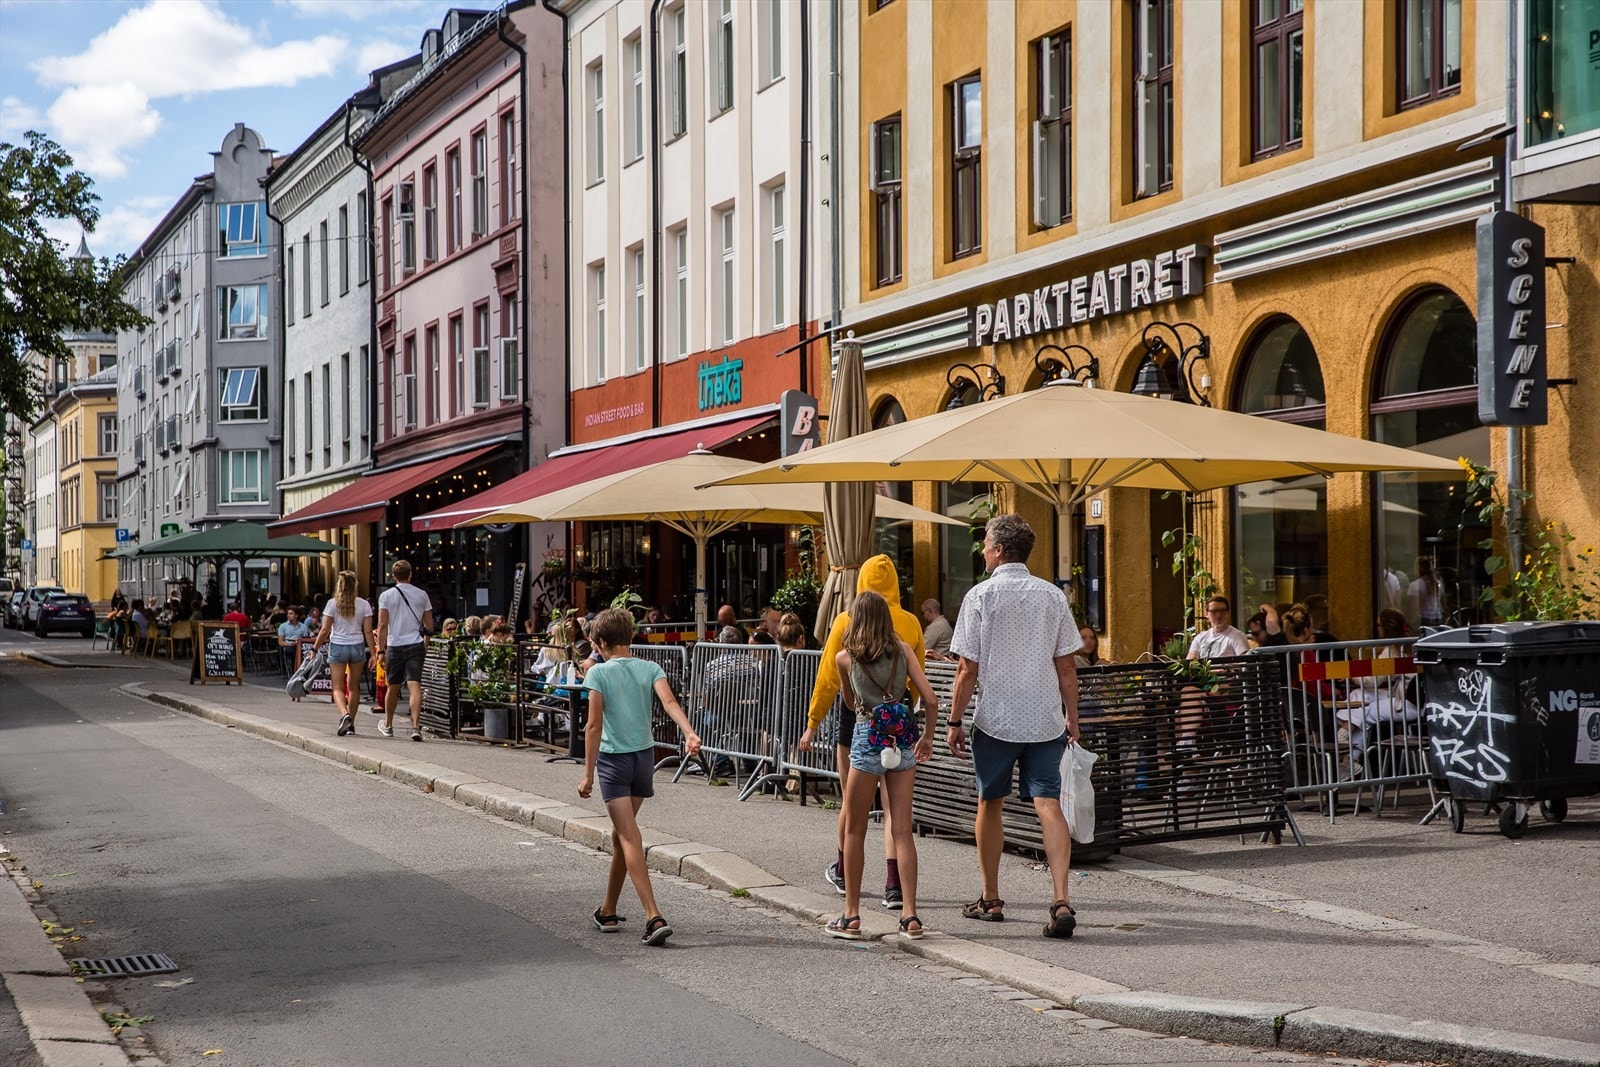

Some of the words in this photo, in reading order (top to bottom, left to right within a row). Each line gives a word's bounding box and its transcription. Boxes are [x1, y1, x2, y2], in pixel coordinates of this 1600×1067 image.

[975, 243, 1198, 347] PARKTEATRET
[1505, 237, 1538, 410] SCENE
[698, 354, 743, 412] theka
[585, 411, 600, 427] INDIAN
[600, 408, 616, 424] STREET
[616, 405, 631, 420] FOOD
[634, 402, 645, 416] BAR
[1093, 502, 1099, 516] 11
[23, 541, 30, 549] P
[118, 530, 126, 541] P
[1549, 689, 1578, 712] NG
